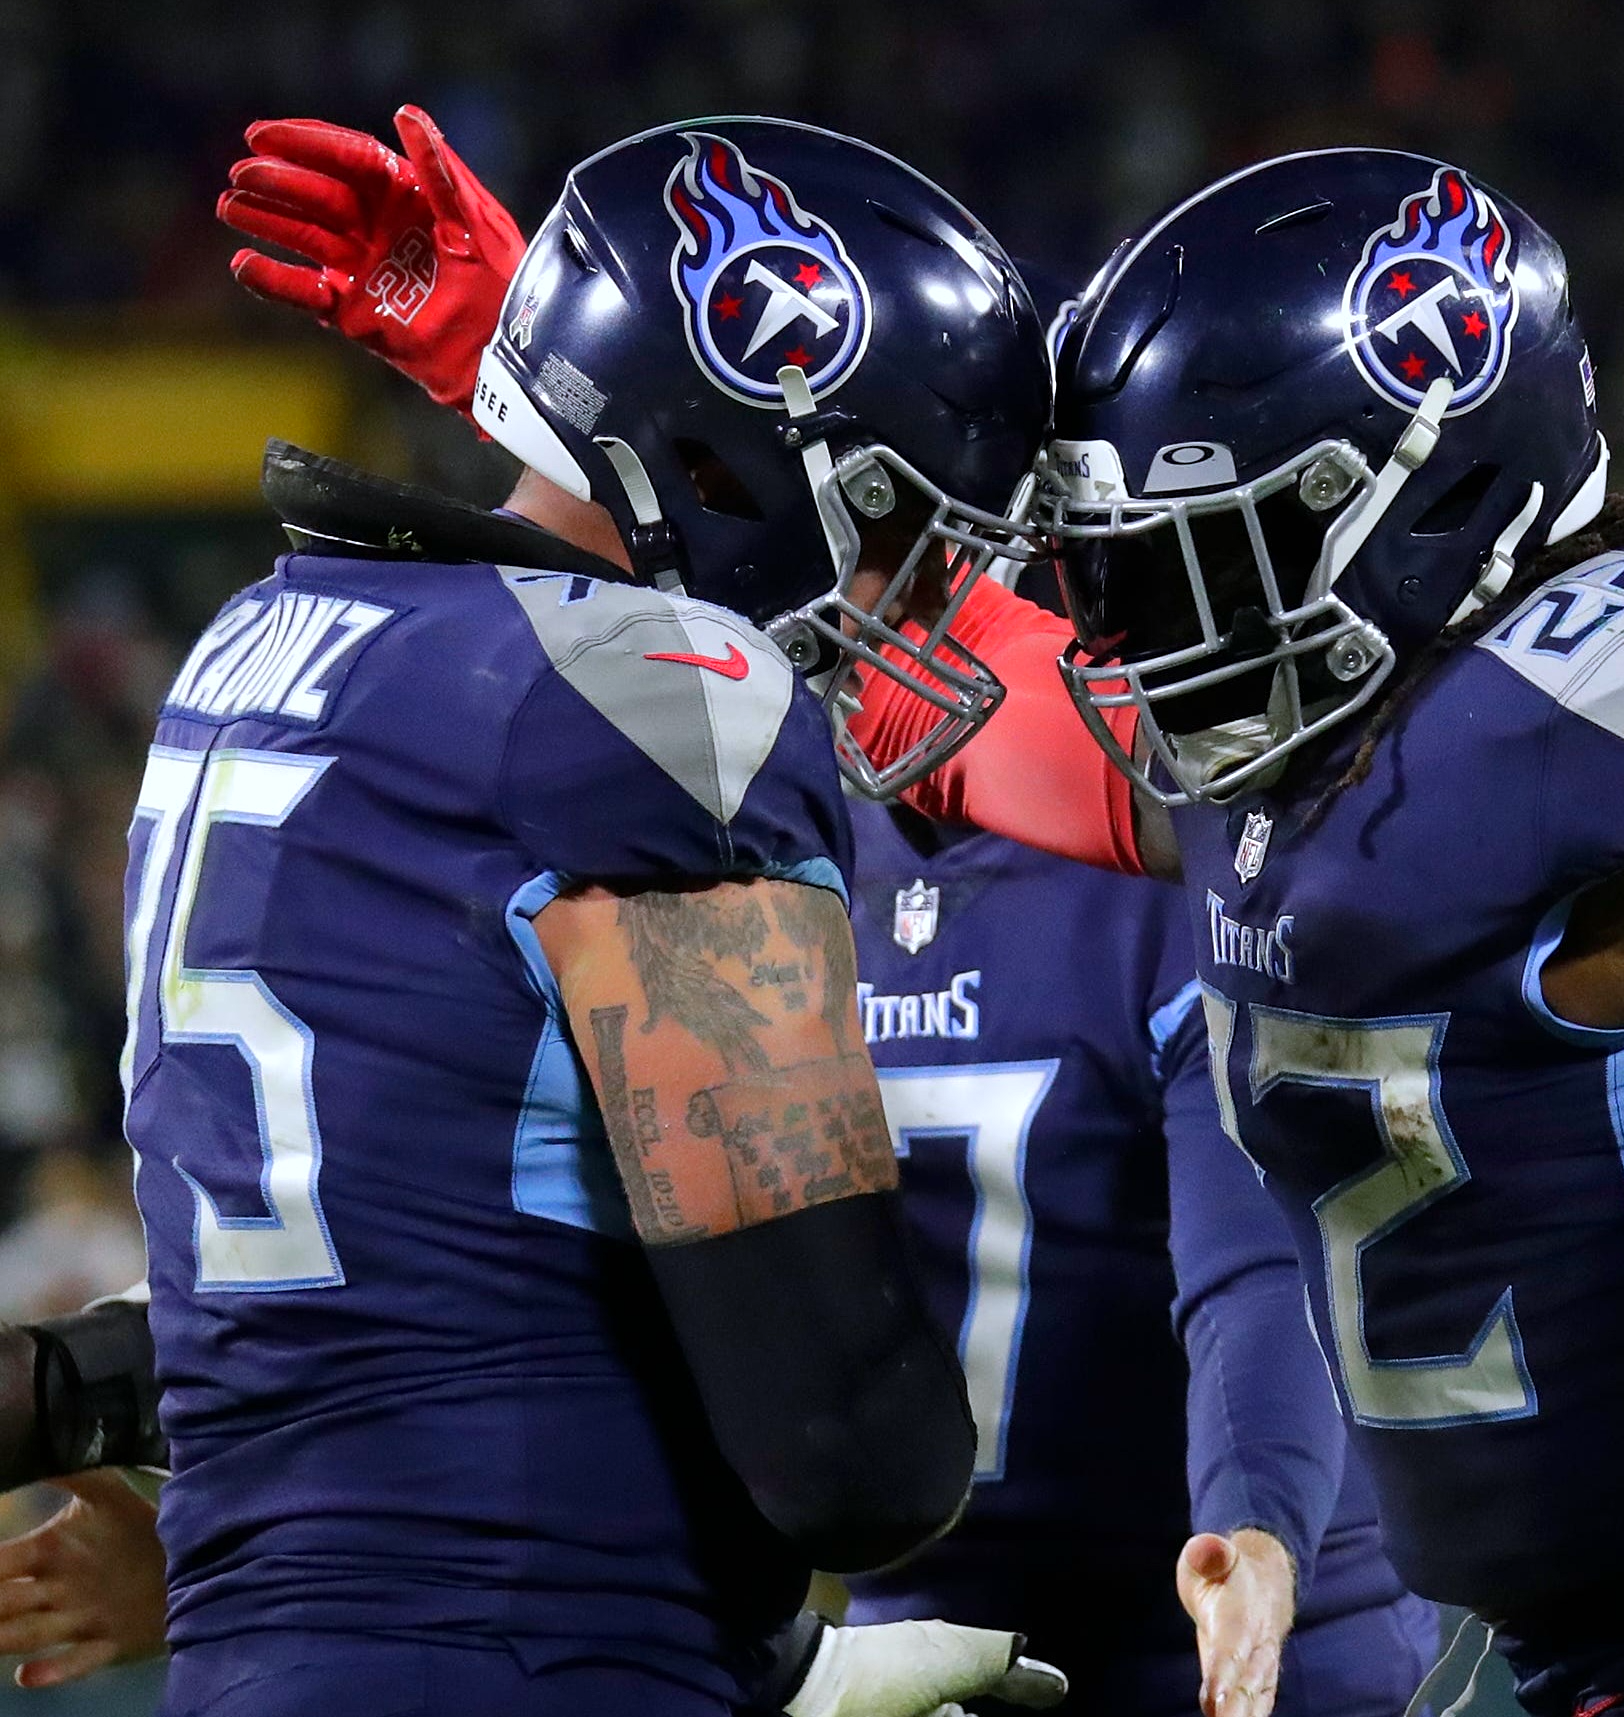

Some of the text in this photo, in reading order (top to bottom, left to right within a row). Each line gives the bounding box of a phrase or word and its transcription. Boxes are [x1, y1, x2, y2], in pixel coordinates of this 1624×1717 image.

[365, 227, 438, 326] 22
[165, 590, 395, 722] RADUNZ
[1206, 888, 1294, 985] TITANS
[119, 744, 346, 1294] 75
